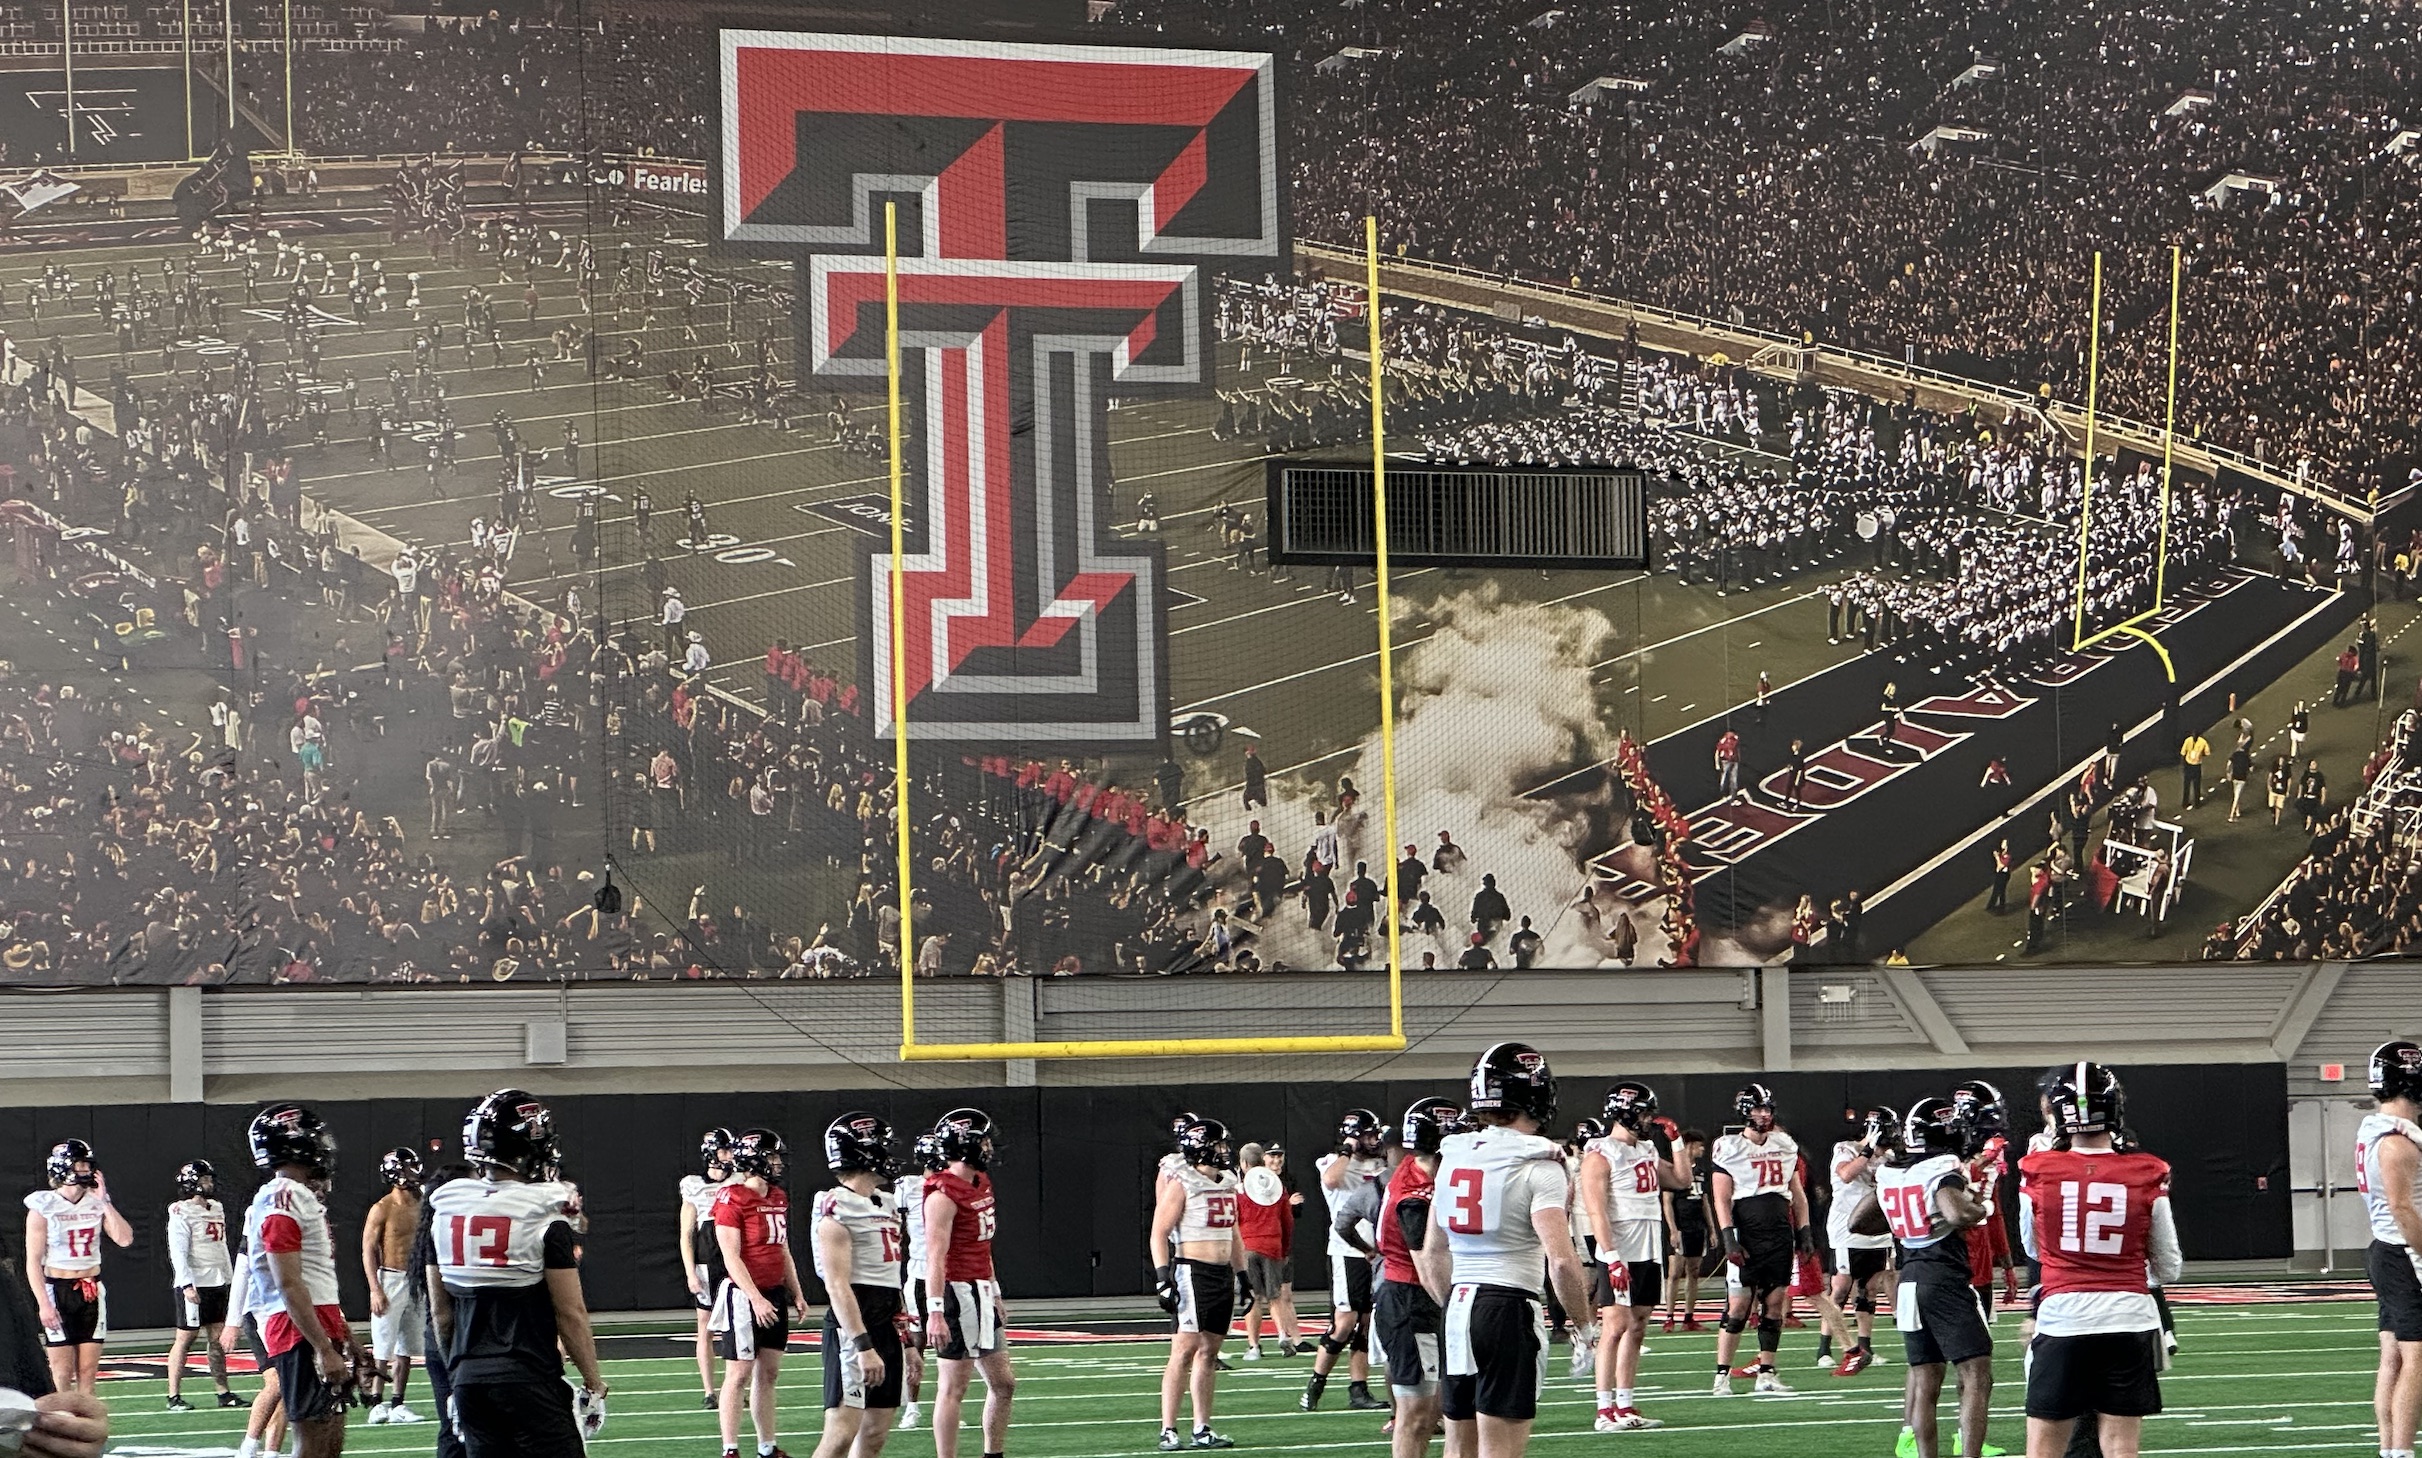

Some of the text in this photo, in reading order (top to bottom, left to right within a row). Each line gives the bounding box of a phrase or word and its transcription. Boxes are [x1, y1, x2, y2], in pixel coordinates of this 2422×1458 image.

[1751, 1160, 1784, 1188] 78
[1207, 1197, 1237, 1228] 23
[1448, 1168, 1485, 1236] 3
[1883, 1184, 1932, 1239] 20
[2060, 1180, 2128, 1255] 12
[67, 1227, 95, 1258] 17
[450, 1215, 512, 1267] 13
[765, 1213, 787, 1245] 16
